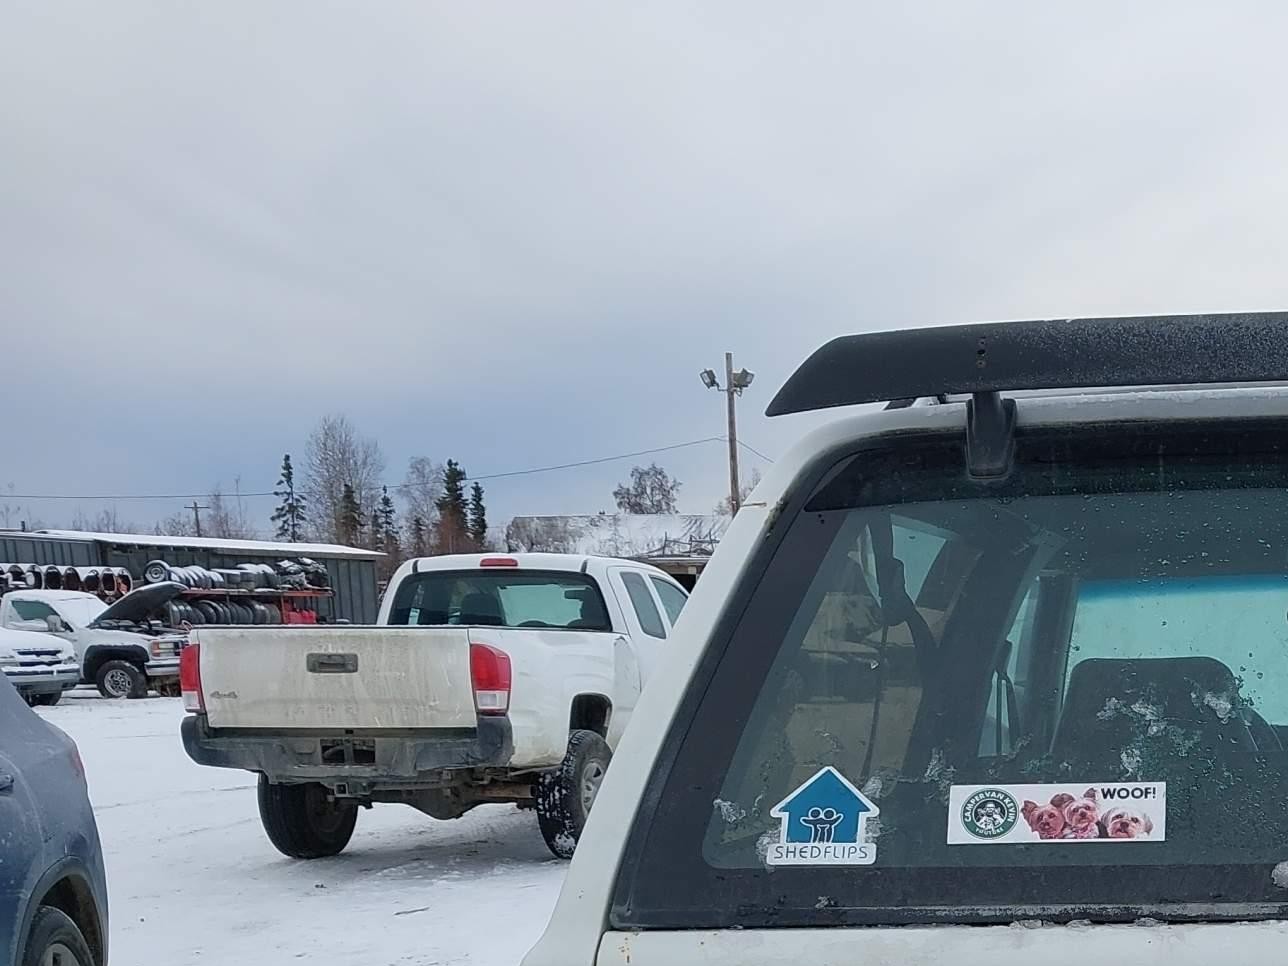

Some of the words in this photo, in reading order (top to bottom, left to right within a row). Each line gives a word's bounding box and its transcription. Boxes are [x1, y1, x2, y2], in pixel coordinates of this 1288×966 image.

[1101, 787, 1157, 799] WOOF!
[964, 791, 1005, 822] CAMPERVAN
[1003, 797, 1017, 822] KEVIN
[773, 845, 869, 859] SHEDFLIPS
